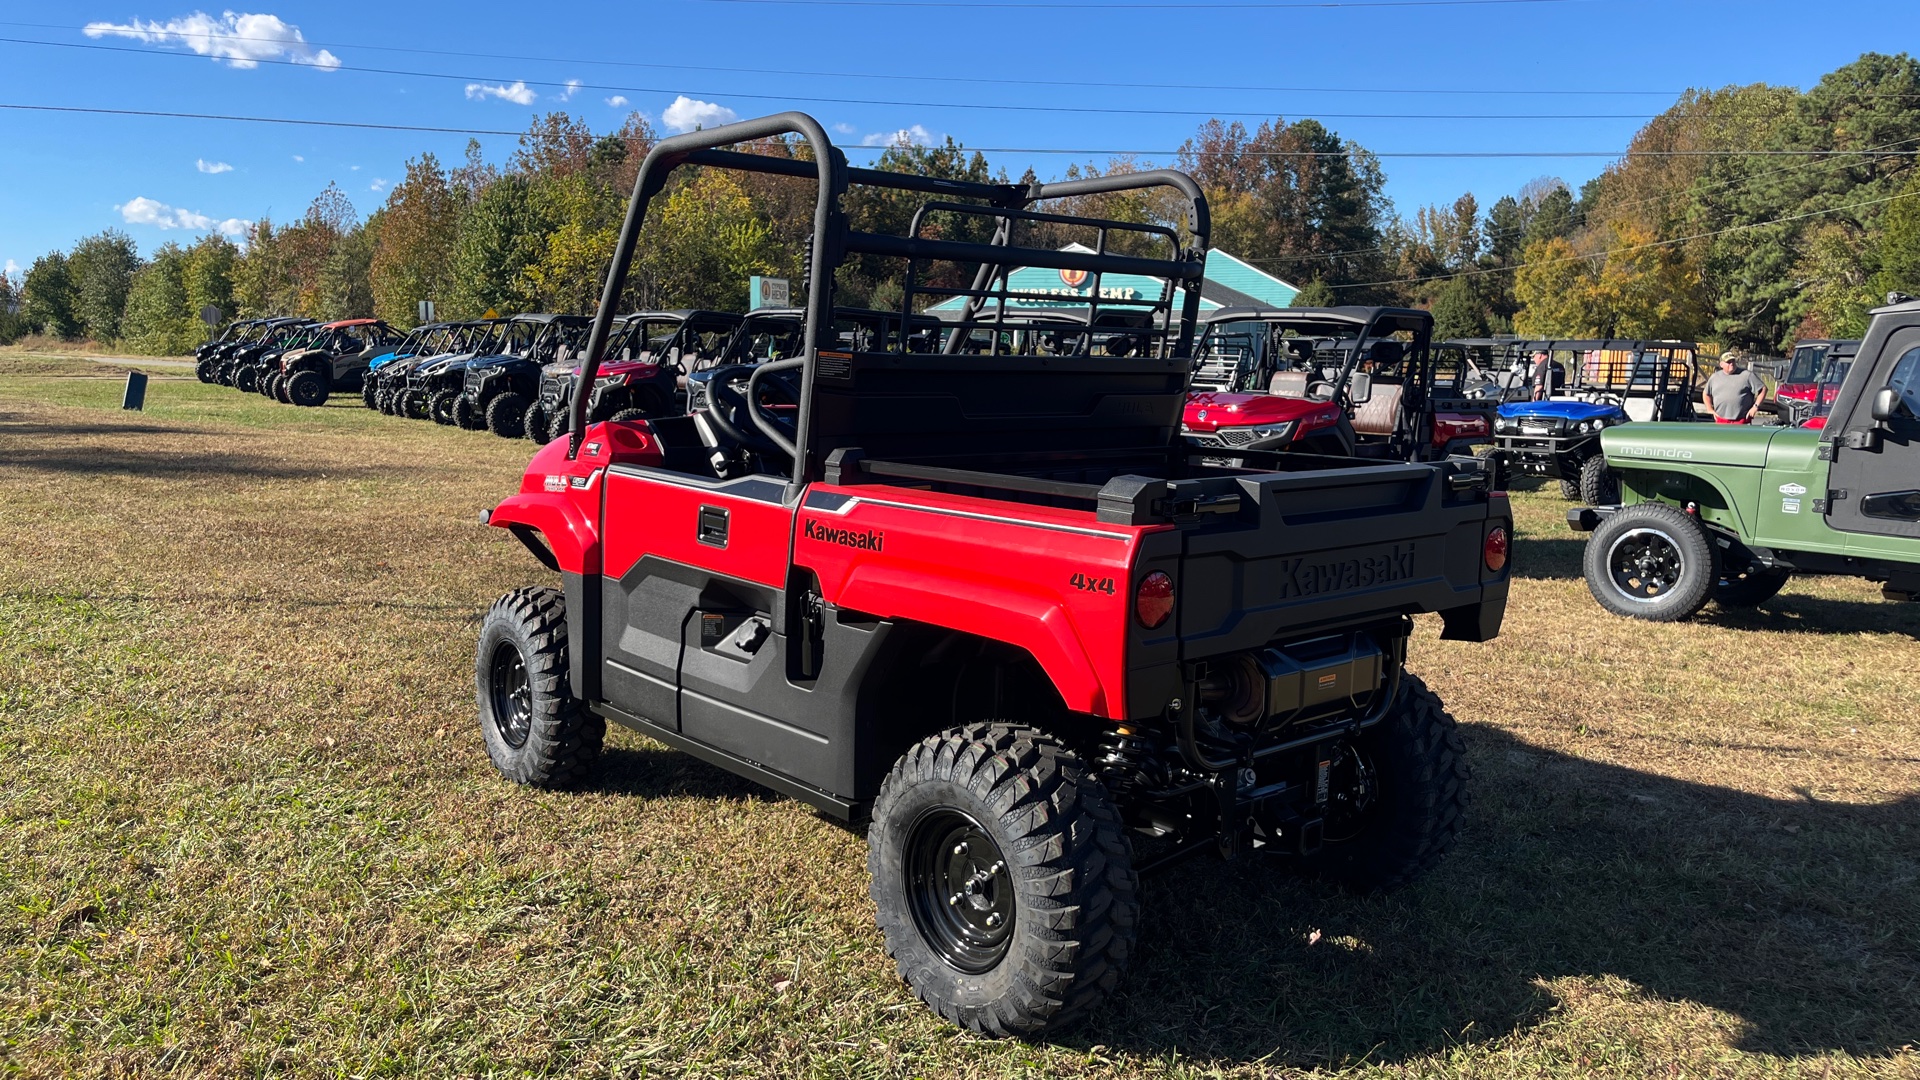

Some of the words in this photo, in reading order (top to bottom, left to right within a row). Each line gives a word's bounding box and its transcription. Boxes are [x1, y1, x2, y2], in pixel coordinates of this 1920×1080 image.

[771, 290, 787, 300] HEMP
[1620, 446, 1692, 458] mahindra
[804, 518, 884, 552] Kawasaki
[1279, 542, 1416, 599] Kawasaki
[1070, 572, 1116, 596] 4x4
